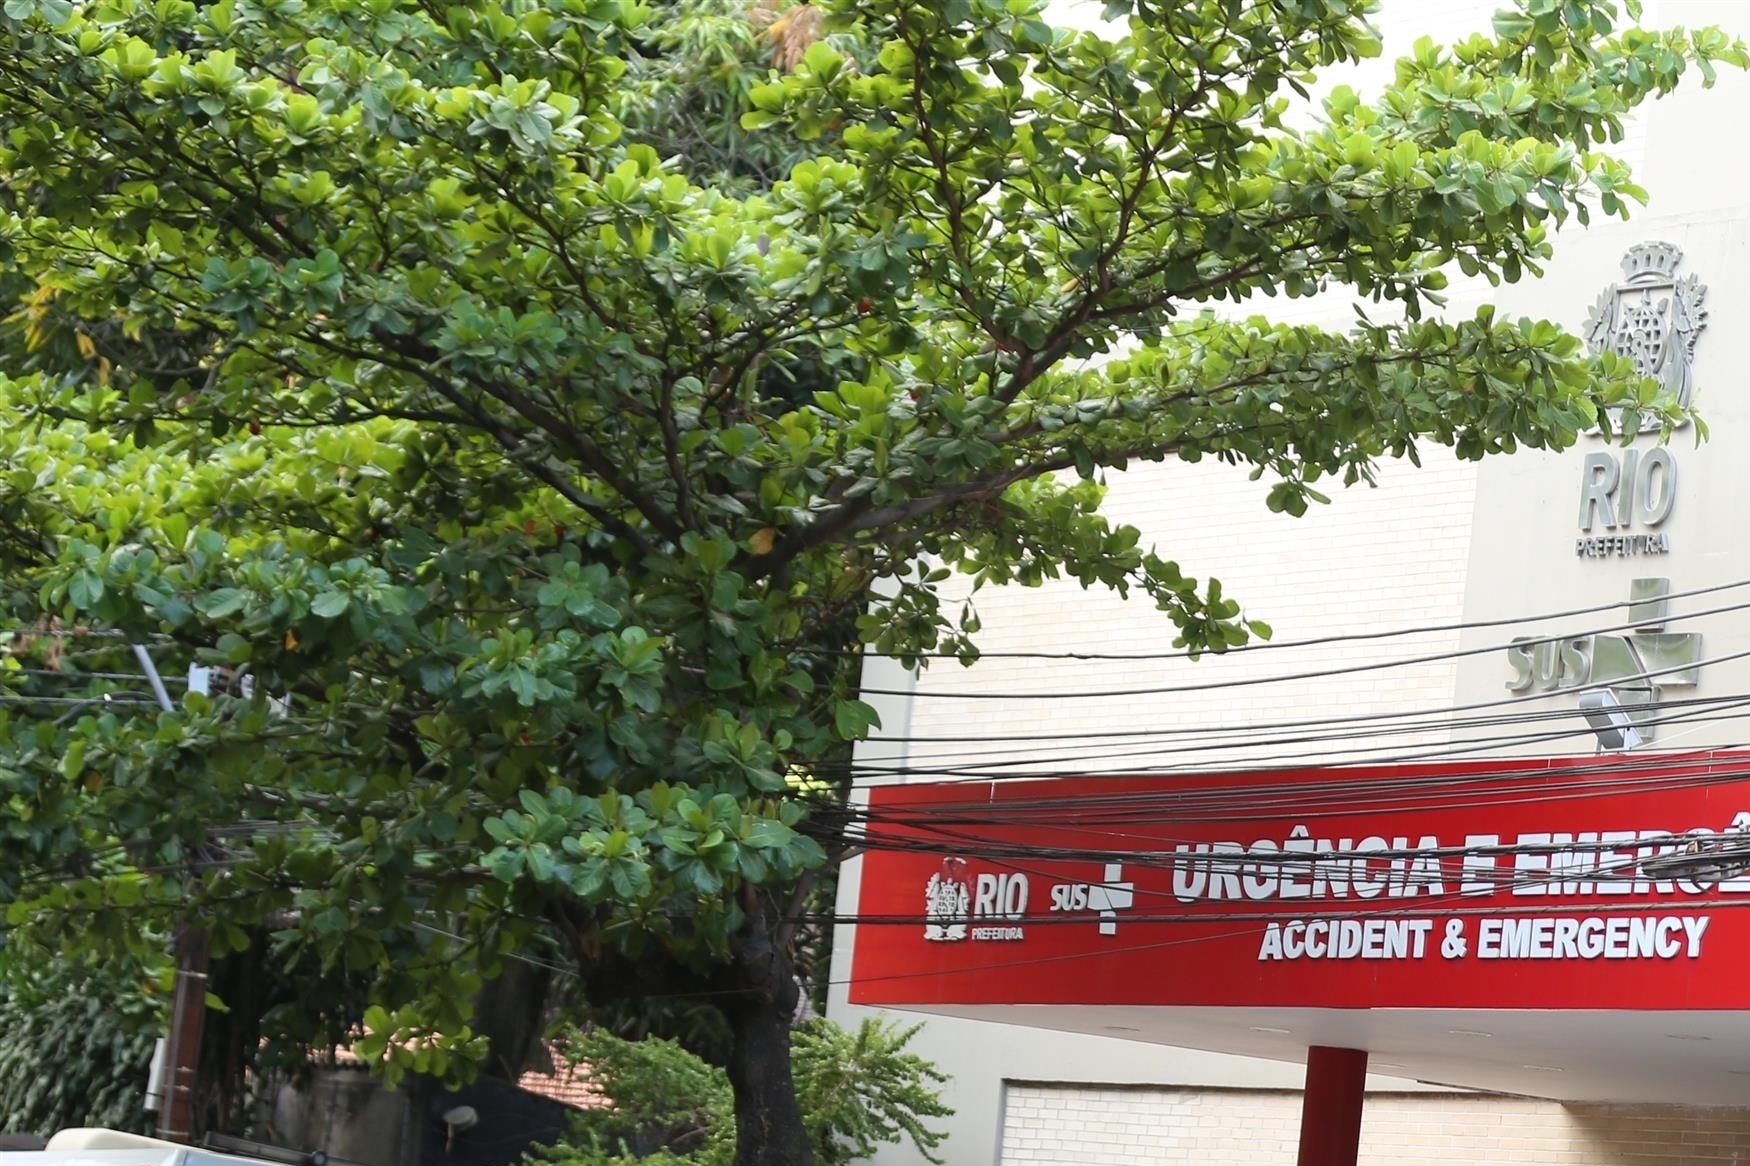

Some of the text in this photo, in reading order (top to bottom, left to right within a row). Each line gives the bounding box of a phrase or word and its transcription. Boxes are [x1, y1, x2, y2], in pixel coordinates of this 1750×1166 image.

[1578, 447, 1678, 531] RIO
[1504, 635, 1591, 691] SUS
[1172, 824, 1446, 903] URGÊNCIA
[1461, 834, 1499, 897] E
[974, 873, 1029, 921] RIO
[1050, 884, 1089, 912] SUS
[972, 927, 1024, 941] PREFEITURA
[1258, 915, 1710, 961] ACCIDENT & EMERGENCY
